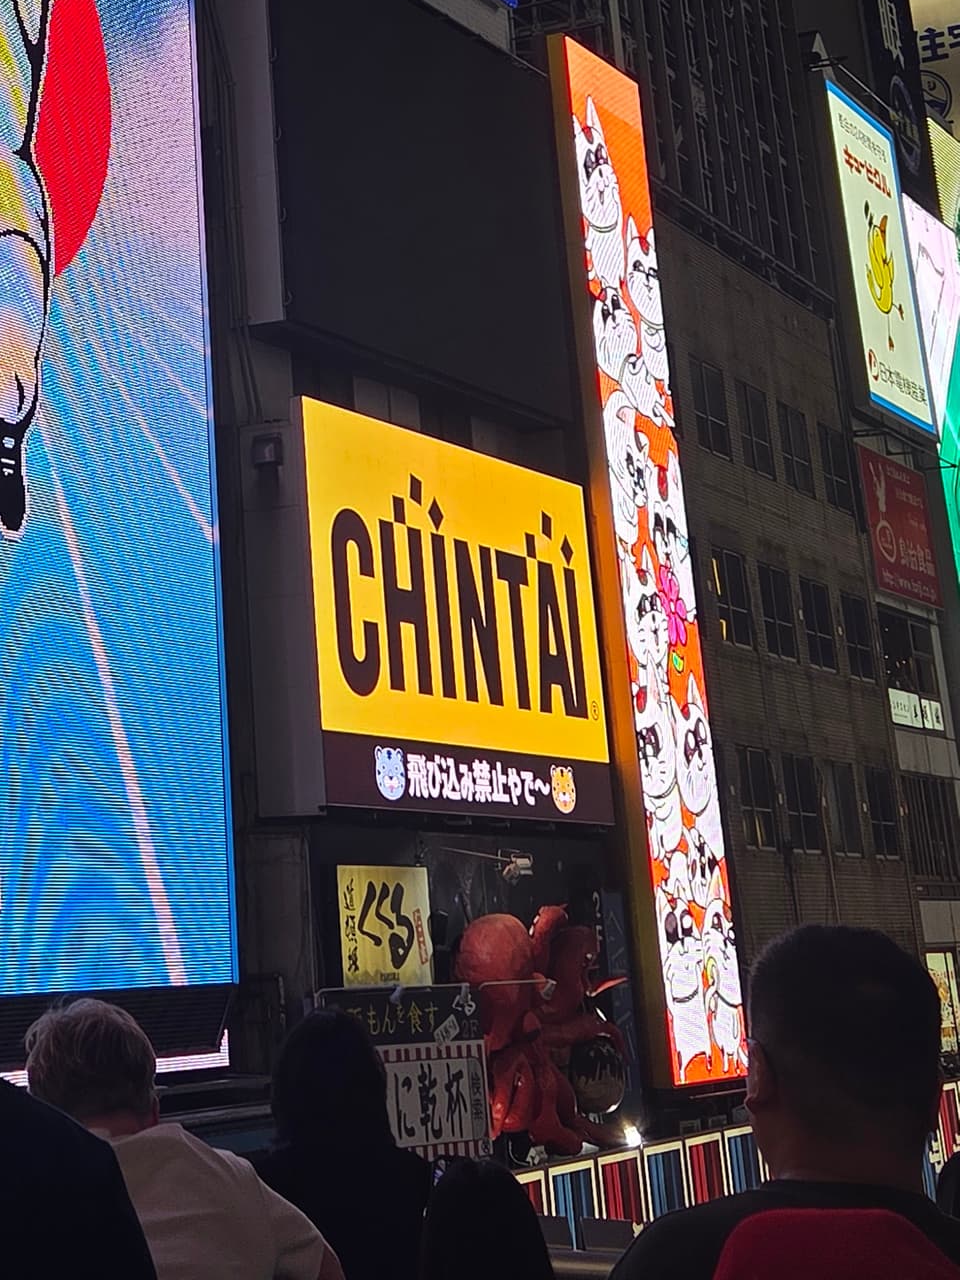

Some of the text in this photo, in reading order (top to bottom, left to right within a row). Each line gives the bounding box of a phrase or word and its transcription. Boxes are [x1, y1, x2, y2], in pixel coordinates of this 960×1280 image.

[330, 474, 588, 719] CHINTAI
[358, 880, 414, 970] くくる
